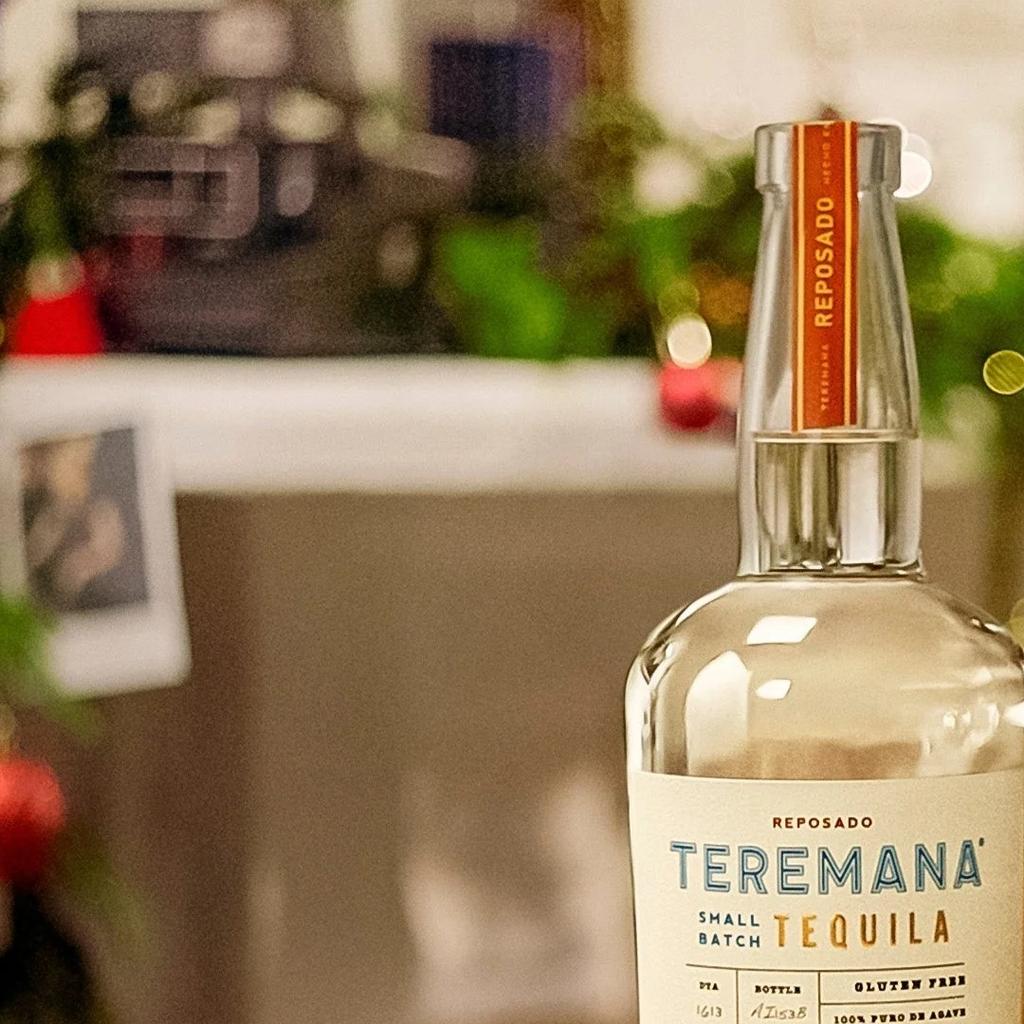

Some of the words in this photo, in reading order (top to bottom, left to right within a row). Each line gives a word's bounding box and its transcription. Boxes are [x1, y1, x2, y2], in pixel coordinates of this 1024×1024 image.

[814, 197, 834, 327] REPOSADO
[773, 816, 873, 829] REPOSADO
[670, 839, 982, 895] TEREMANA
[699, 911, 760, 927] SMALL
[773, 910, 950, 949] TEQUILA
[699, 932, 760, 948] BATCH
[755, 985, 801, 994] BOTTLE
[854, 979, 922, 992] GLUTEN
[929, 975, 966, 989] FREE
[834, 1015, 865, 1024] 100%
[871, 1013, 905, 1023] PURO
[910, 1012, 925, 1021] DE
[929, 1008, 966, 1020] AGAVE
